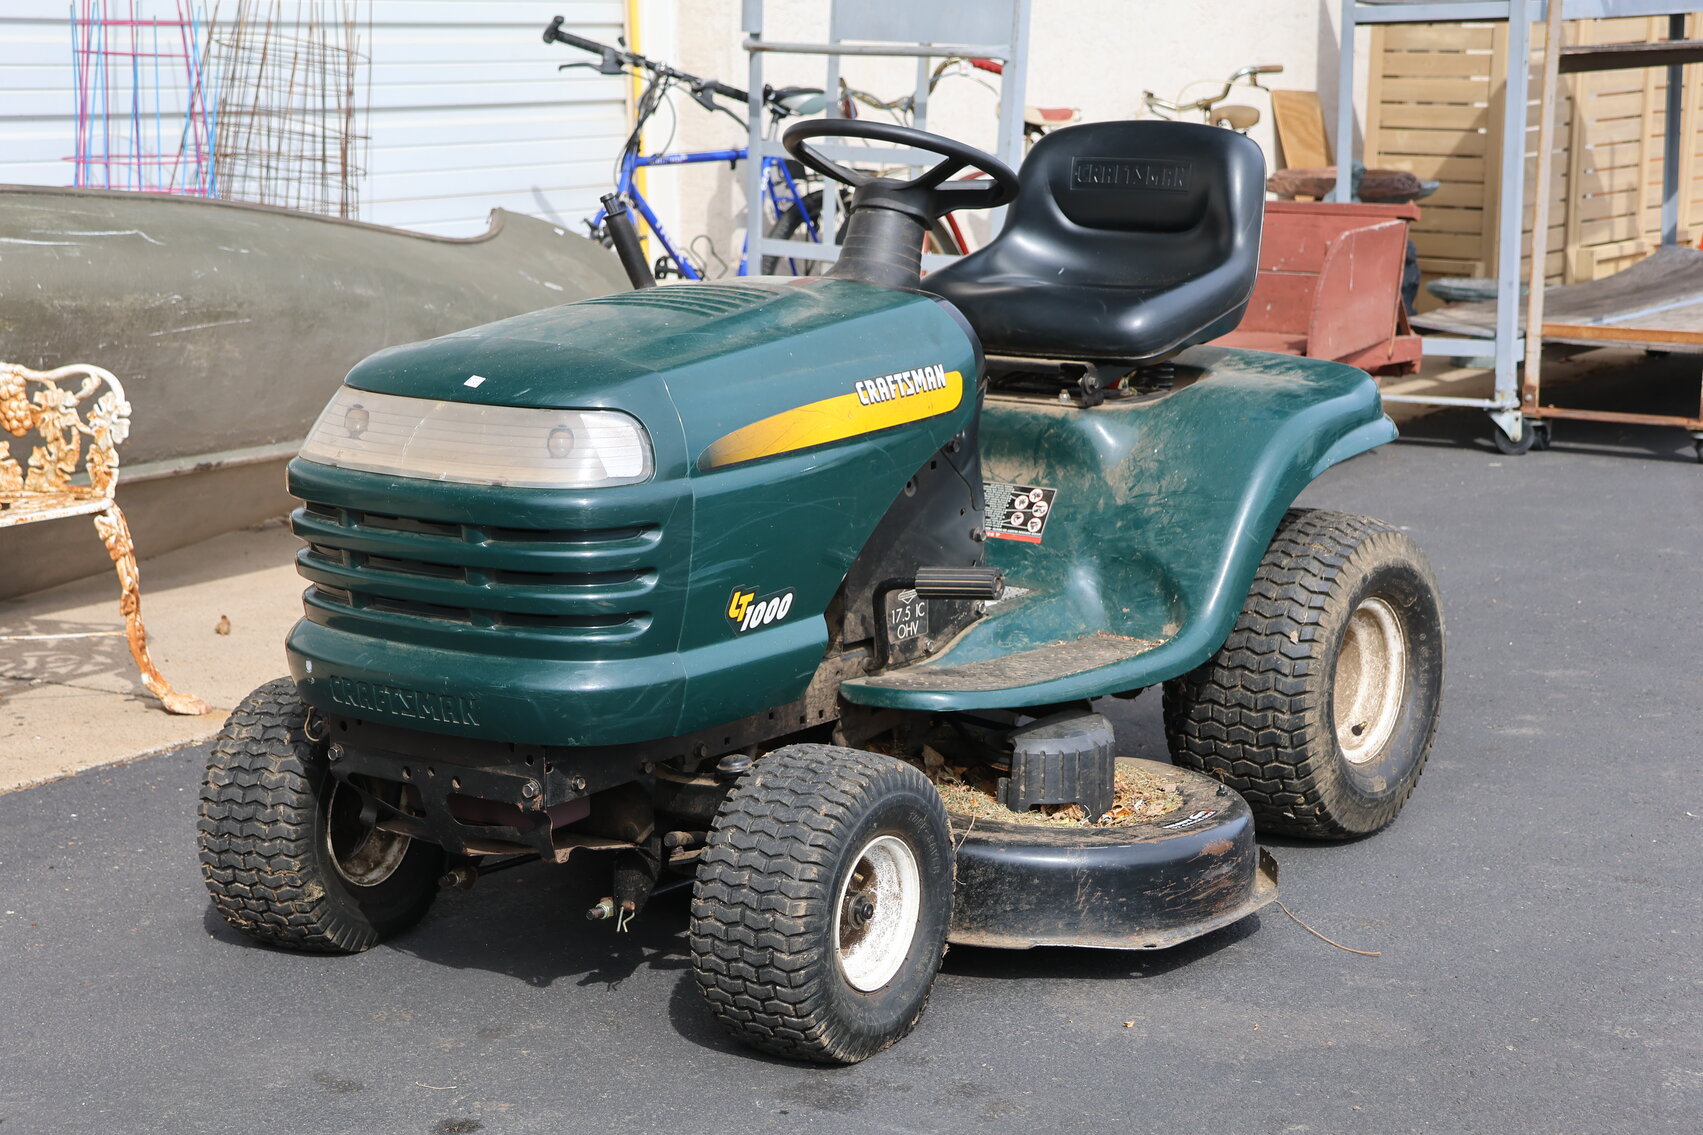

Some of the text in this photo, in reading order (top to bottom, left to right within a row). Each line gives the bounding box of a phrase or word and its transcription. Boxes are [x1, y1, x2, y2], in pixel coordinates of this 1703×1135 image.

[855, 363, 947, 406] CRAFTSMAN
[892, 601, 925, 625] 17.5 IC
[897, 620, 919, 639] OHV
[330, 674, 481, 727] CRAFTSMAN
